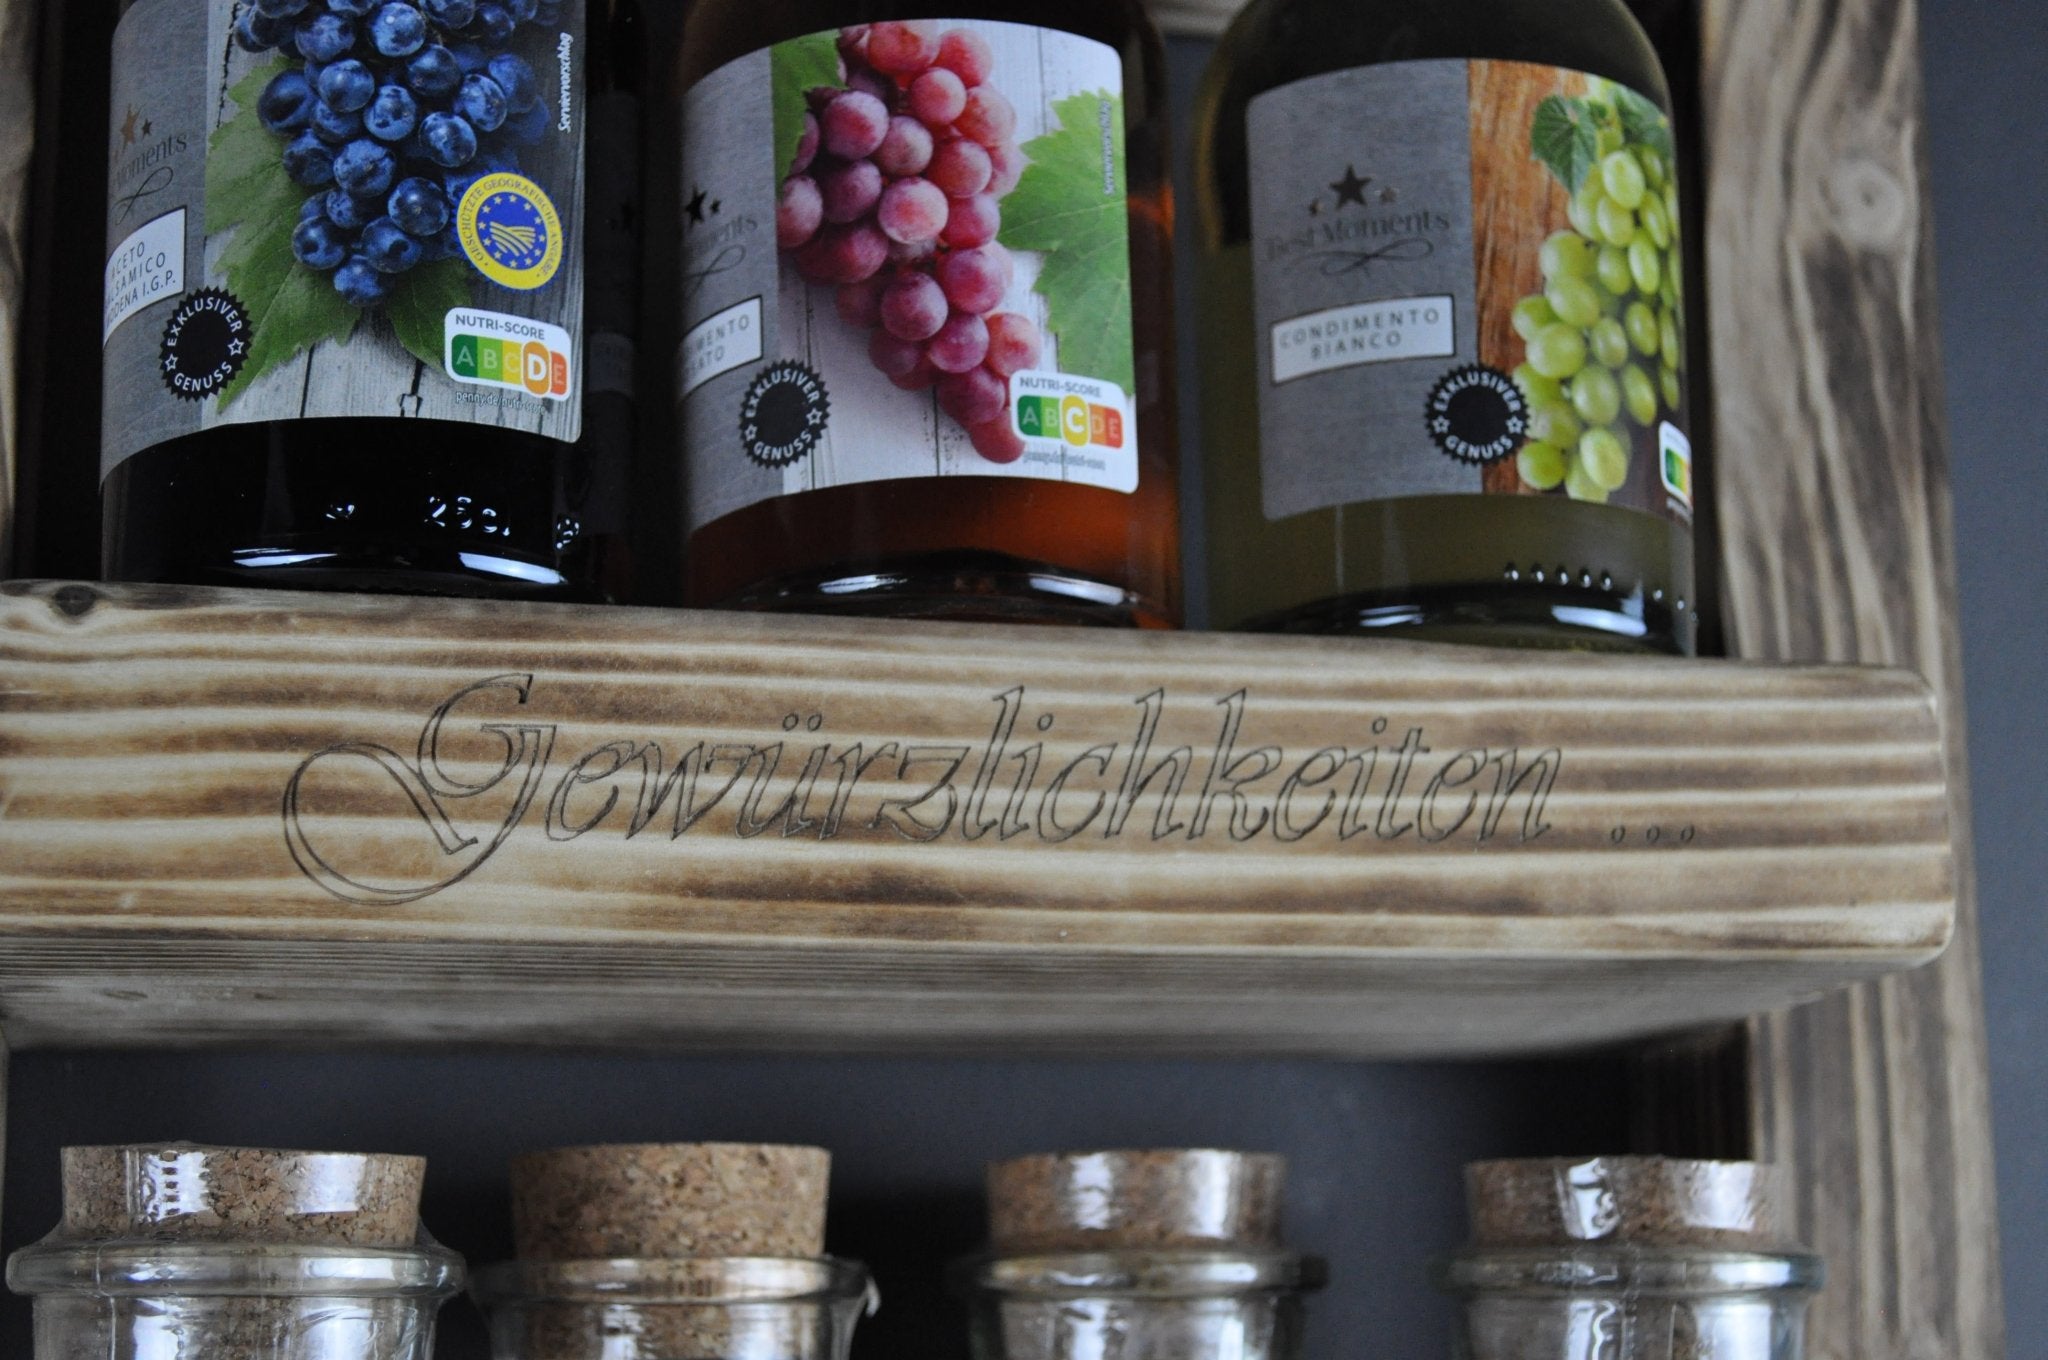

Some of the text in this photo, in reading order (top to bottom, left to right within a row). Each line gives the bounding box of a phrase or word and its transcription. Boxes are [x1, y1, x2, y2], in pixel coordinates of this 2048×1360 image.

[143, 269, 177, 297] I.G.P.
[167, 296, 243, 347] EXKLUSIVER
[455, 314, 545, 340] NUTRI-SCORE
[1279, 307, 1440, 349] CONDIMENTO
[1310, 330, 1402, 360] BIANCO
[174, 361, 232, 392] GENUSS
[528, 353, 547, 381] D
[745, 368, 820, 418] EXKLUSIVER
[1020, 377, 1101, 398] NUTRI-SCORE
[1433, 371, 1521, 412] EXKLUSIVER
[1066, 407, 1085, 433] C
[753, 430, 812, 460] GENUSS
[1445, 434, 1513, 459] GENUSS
[282, 673, 1562, 907] Gewürzlichkeiten
